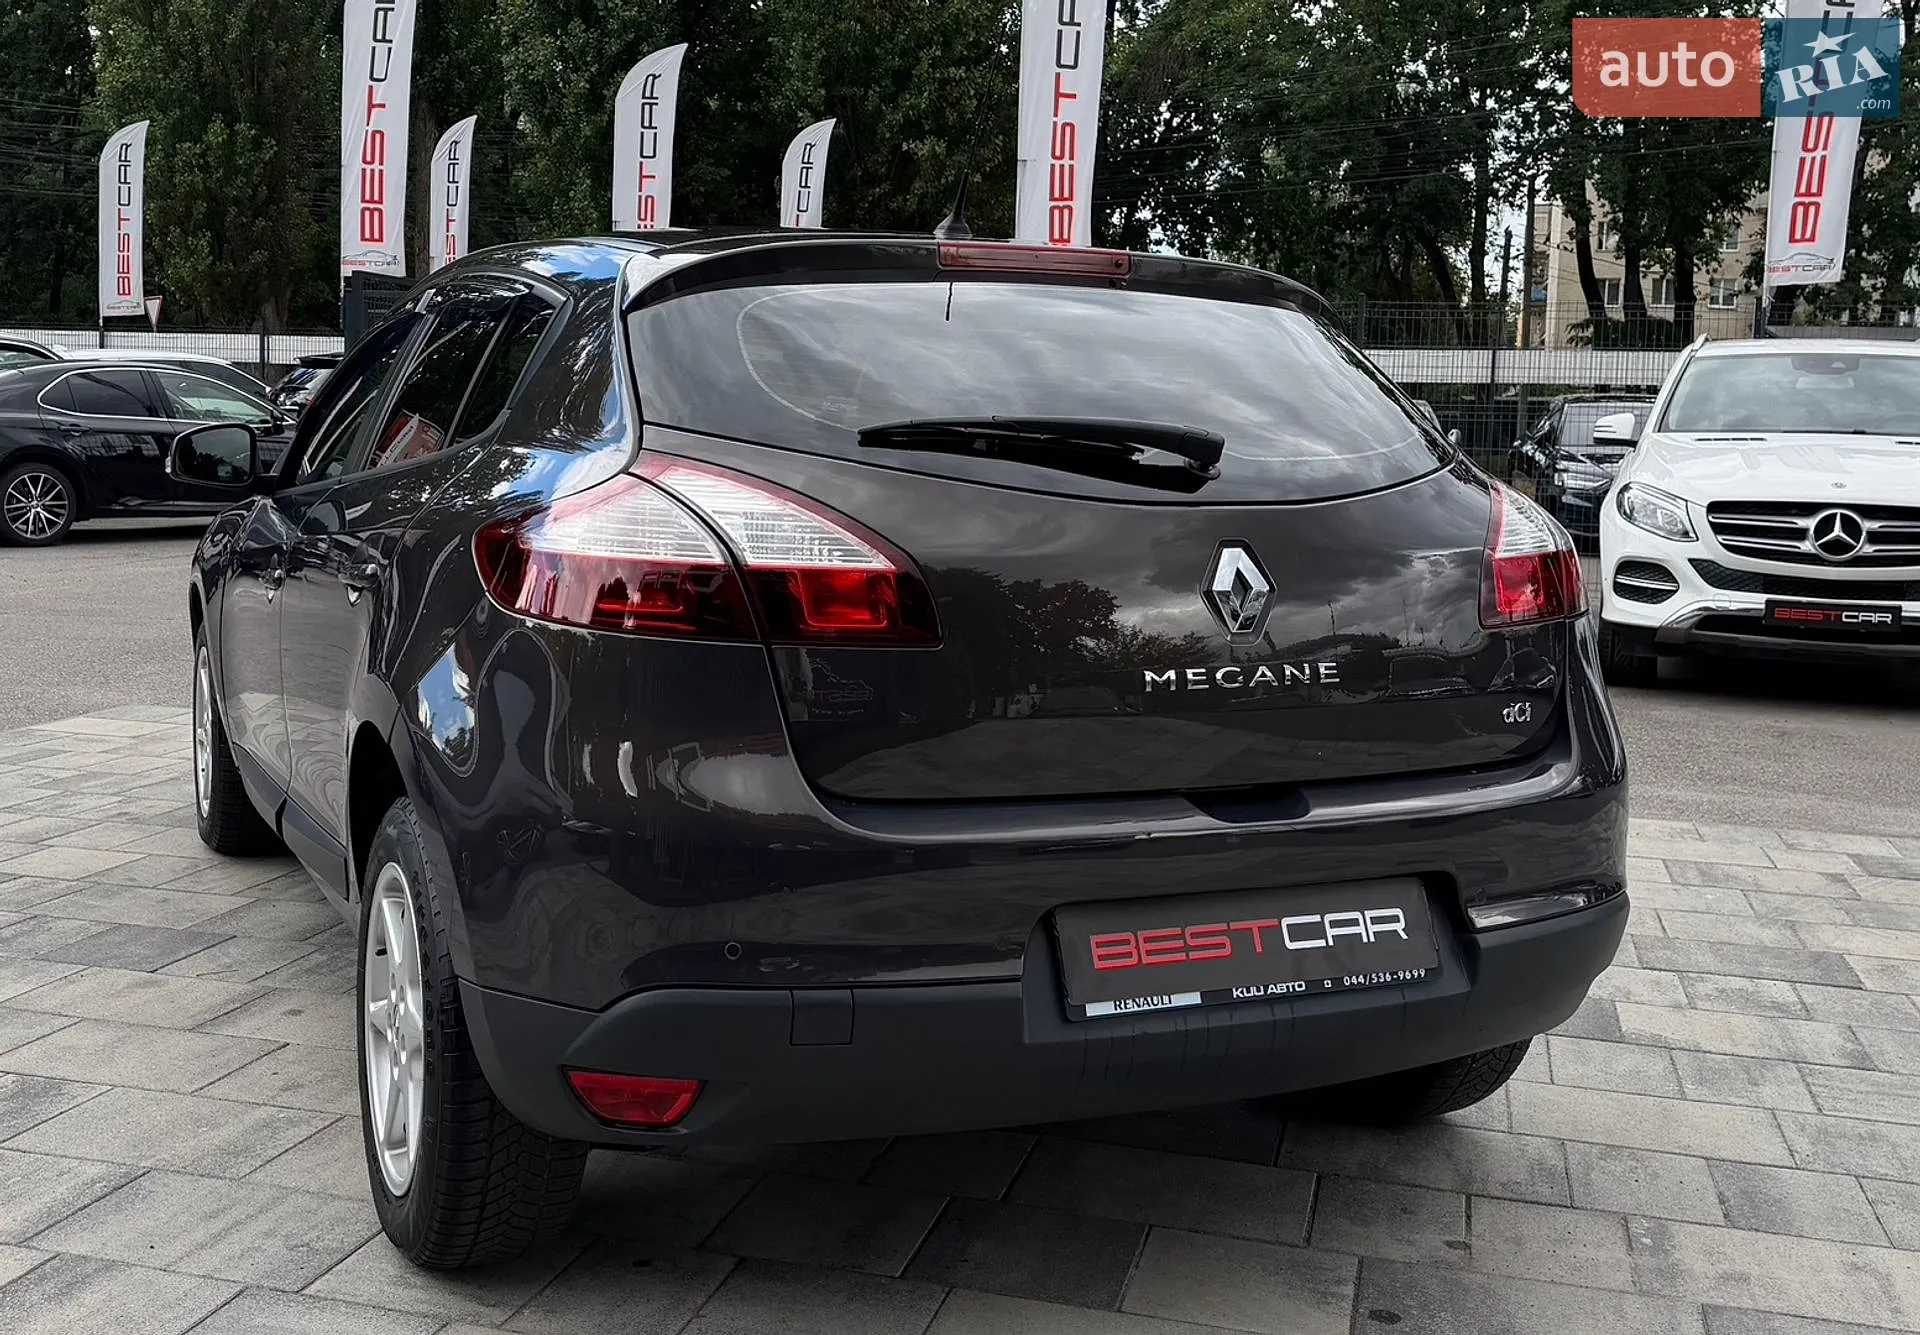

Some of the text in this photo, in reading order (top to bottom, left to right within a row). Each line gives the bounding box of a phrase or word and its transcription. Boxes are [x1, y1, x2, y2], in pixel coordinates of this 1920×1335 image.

[359, 0, 396, 243] BESTCA
[637, 73, 663, 230] STCAR
[117, 142, 132, 296] BESTCAR
[1774, 607, 1893, 625] BESTCAR
[1143, 662, 1340, 692] MEGANE
[1089, 908, 1408, 970] BESTCAR
[1342, 968, 1426, 986] 044/536-9699
